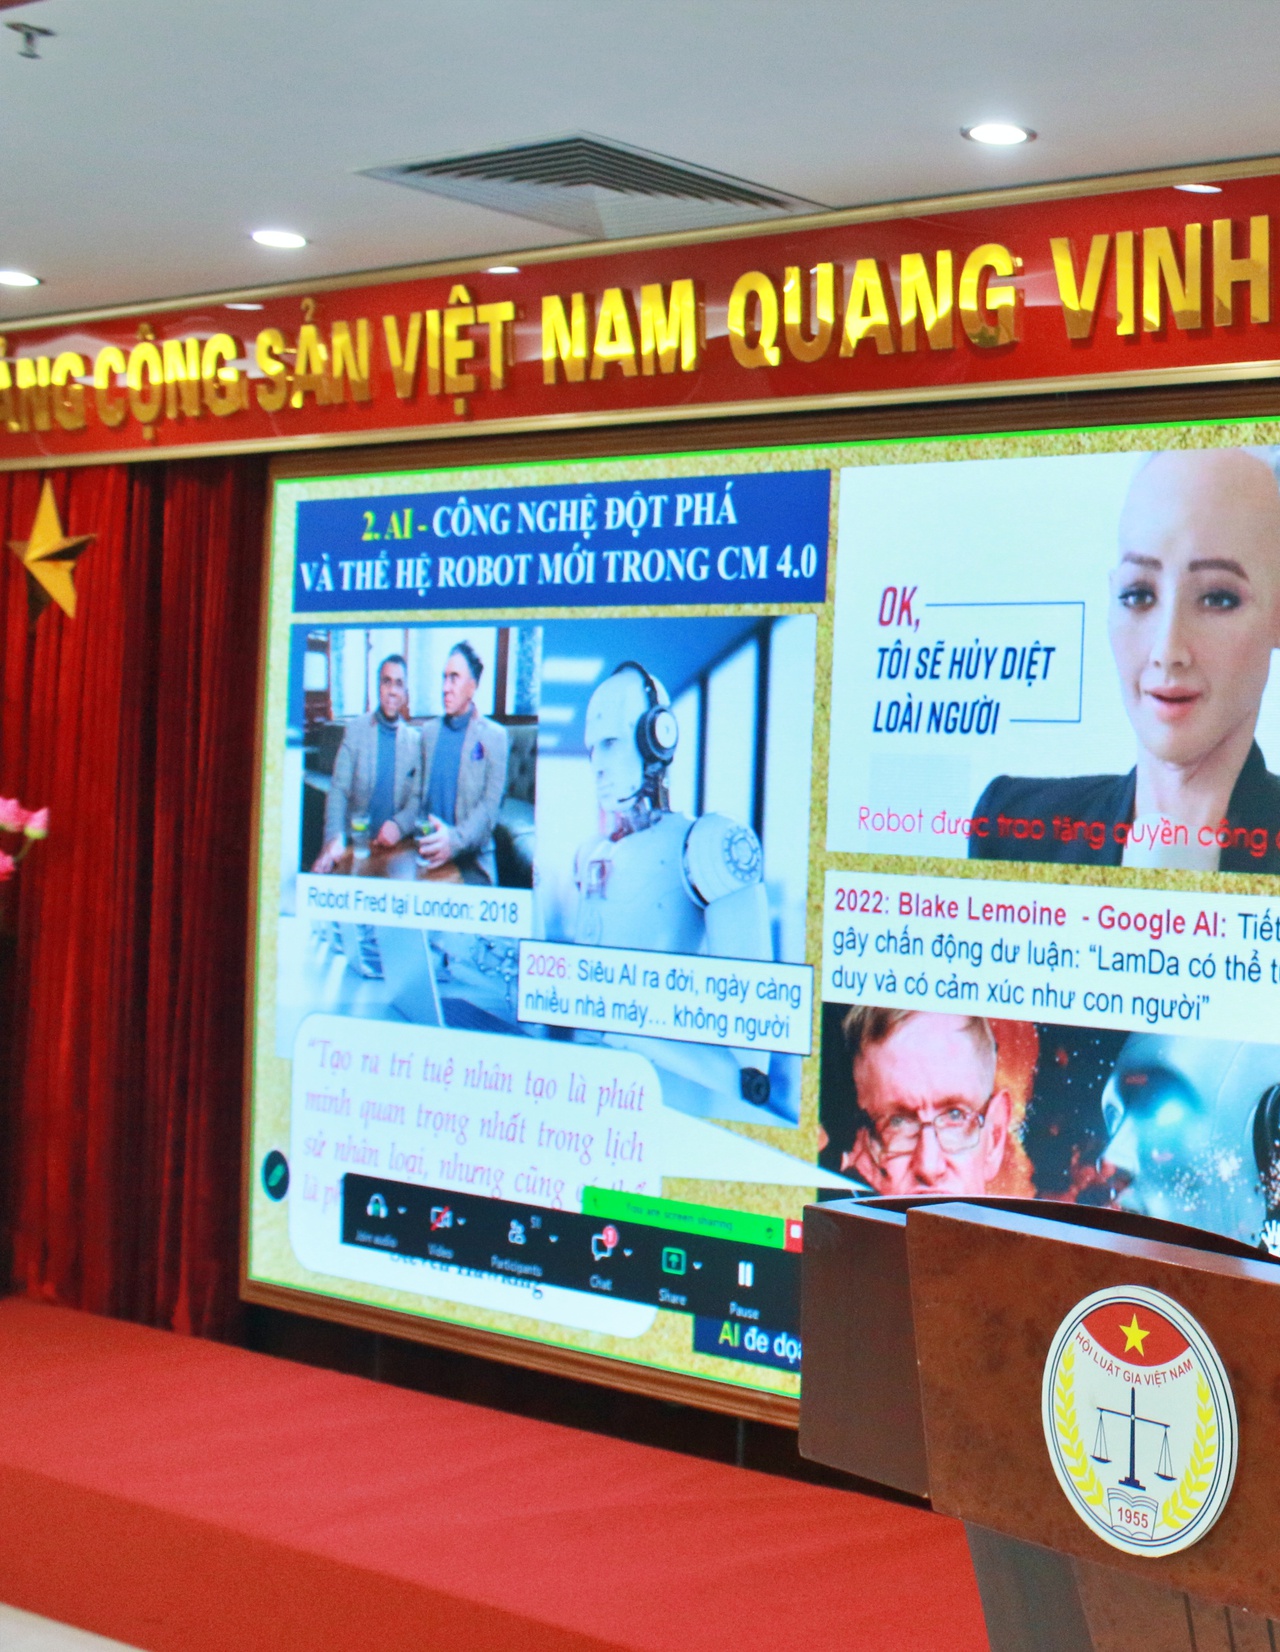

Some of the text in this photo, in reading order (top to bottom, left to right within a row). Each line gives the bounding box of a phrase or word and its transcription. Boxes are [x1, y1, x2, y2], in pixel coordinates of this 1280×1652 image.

[93, 322, 240, 440] CỘNG
[256, 299, 370, 409] SẢN
[382, 284, 516, 416] VIỆT
[541, 278, 697, 385] NAM
[728, 242, 1022, 370] QUANG
[1049, 213, 1270, 340] VINH
[384, 508, 414, 540] AI
[433, 496, 511, 538] CÔNG
[517, 493, 598, 540] NGHỆ
[604, 490, 669, 538] ĐỘT
[674, 481, 738, 527] PHÁ
[300, 542, 818, 597] VÀ THẾ HỆ ROBOT MỚI TRONG CM 4.0
[878, 586, 920, 632] OK,
[877, 638, 1056, 687] TÔI SẼ HỦY DIỆT
[873, 692, 1000, 735] LOÀI NGƯỜI
[858, 806, 923, 833] Robot
[931, 810, 990, 840] được
[997, 812, 1045, 840] trao
[1113, 818, 1189, 850] quyền
[1197, 816, 1269, 857] công
[308, 886, 349, 910] Robot
[354, 890, 386, 913] Fred
[414, 896, 474, 920] London:
[480, 900, 519, 924] 2018
[835, 887, 889, 914] 2022:
[899, 891, 959, 919] Blake
[968, 896, 1067, 926] Lemoine
[1098, 905, 1186, 940] Google
[1193, 910, 1226, 937] AI:
[832, 926, 869, 957] gây
[875, 925, 924, 956] chấn
[931, 933, 983, 968] động
[991, 938, 1020, 964] dư
[1027, 940, 1080, 972] luận:
[1188, 953, 1216, 979] có
[1225, 949, 1262, 983] thể
[527, 954, 801, 1009] 2026: Siêu AI ra đời, ngày càng
[831, 965, 867, 997] duy
[875, 970, 897, 993] và
[904, 972, 928, 996] có
[935, 973, 979, 1001] cảm
[987, 979, 1025, 1005] xúc
[1032, 983, 1076, 1010] như
[1083, 991, 1123, 1014] con
[525, 986, 569, 1014] nhiều
[575, 994, 606, 1018] nhà
[673, 1004, 728, 1038] không
[734, 1014, 790, 1041] người
[361, 1054, 380, 1074] ra
[390, 1052, 414, 1079] trí
[422, 1056, 454, 1092] tuệ
[464, 1060, 512, 1093] nhân
[525, 1070, 557, 1105] tạo
[568, 1072, 586, 1104] là
[596, 1077, 645, 1117] phát
[359, 1100, 406, 1130] quan
[416, 1103, 470, 1146] trọng
[480, 1110, 526, 1144] nhất
[537, 1121, 594, 1166] trong
[605, 1127, 643, 1167] lịch
[439, 1152, 504, 1199] nhưng
[514, 1165, 566, 1209] cũng
[658, 1288, 687, 1305] Share
[729, 1302, 760, 1320] Pause
[718, 1320, 740, 1347] AI
[744, 1325, 769, 1353] đe
[1075, 1331, 1193, 1387] HỘI LUẬT GIA VIỆT NAM
[1117, 1506, 1149, 1529] 1955
